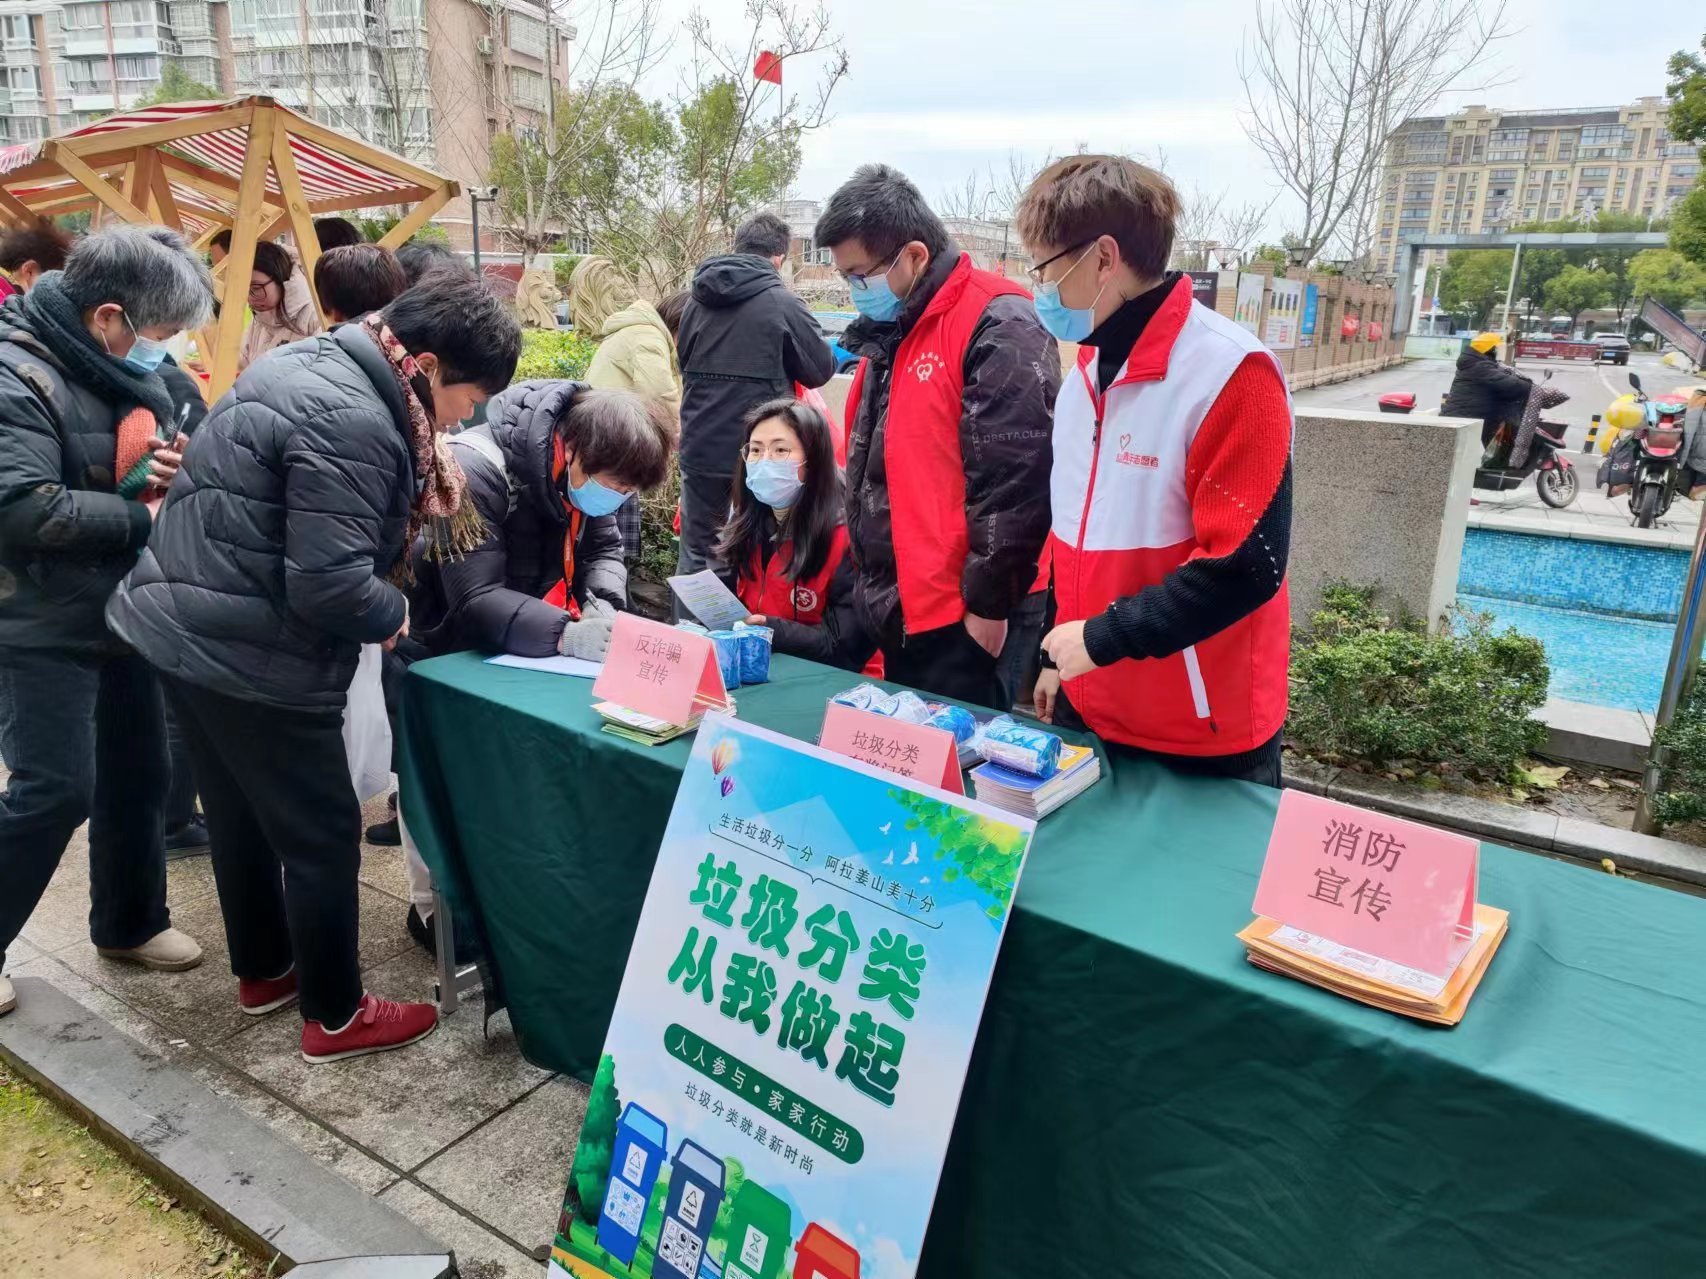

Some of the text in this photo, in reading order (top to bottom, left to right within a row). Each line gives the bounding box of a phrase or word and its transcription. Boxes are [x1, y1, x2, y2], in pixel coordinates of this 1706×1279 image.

[635, 634, 683, 664] 反诈骗
[635, 660, 669, 686] 宣传
[851, 729, 920, 765] 垃圾分类
[719, 812, 935, 913] 生活垃圾分一分 阿拉姜山美十分
[1321, 818, 1407, 873] 消防
[1307, 866, 1392, 923] 宣传
[689, 852, 927, 1021] 垃圾分类
[667, 926, 906, 1108] 从我做起
[684, 1081, 814, 1176] 垃圾分类就是新时尚
